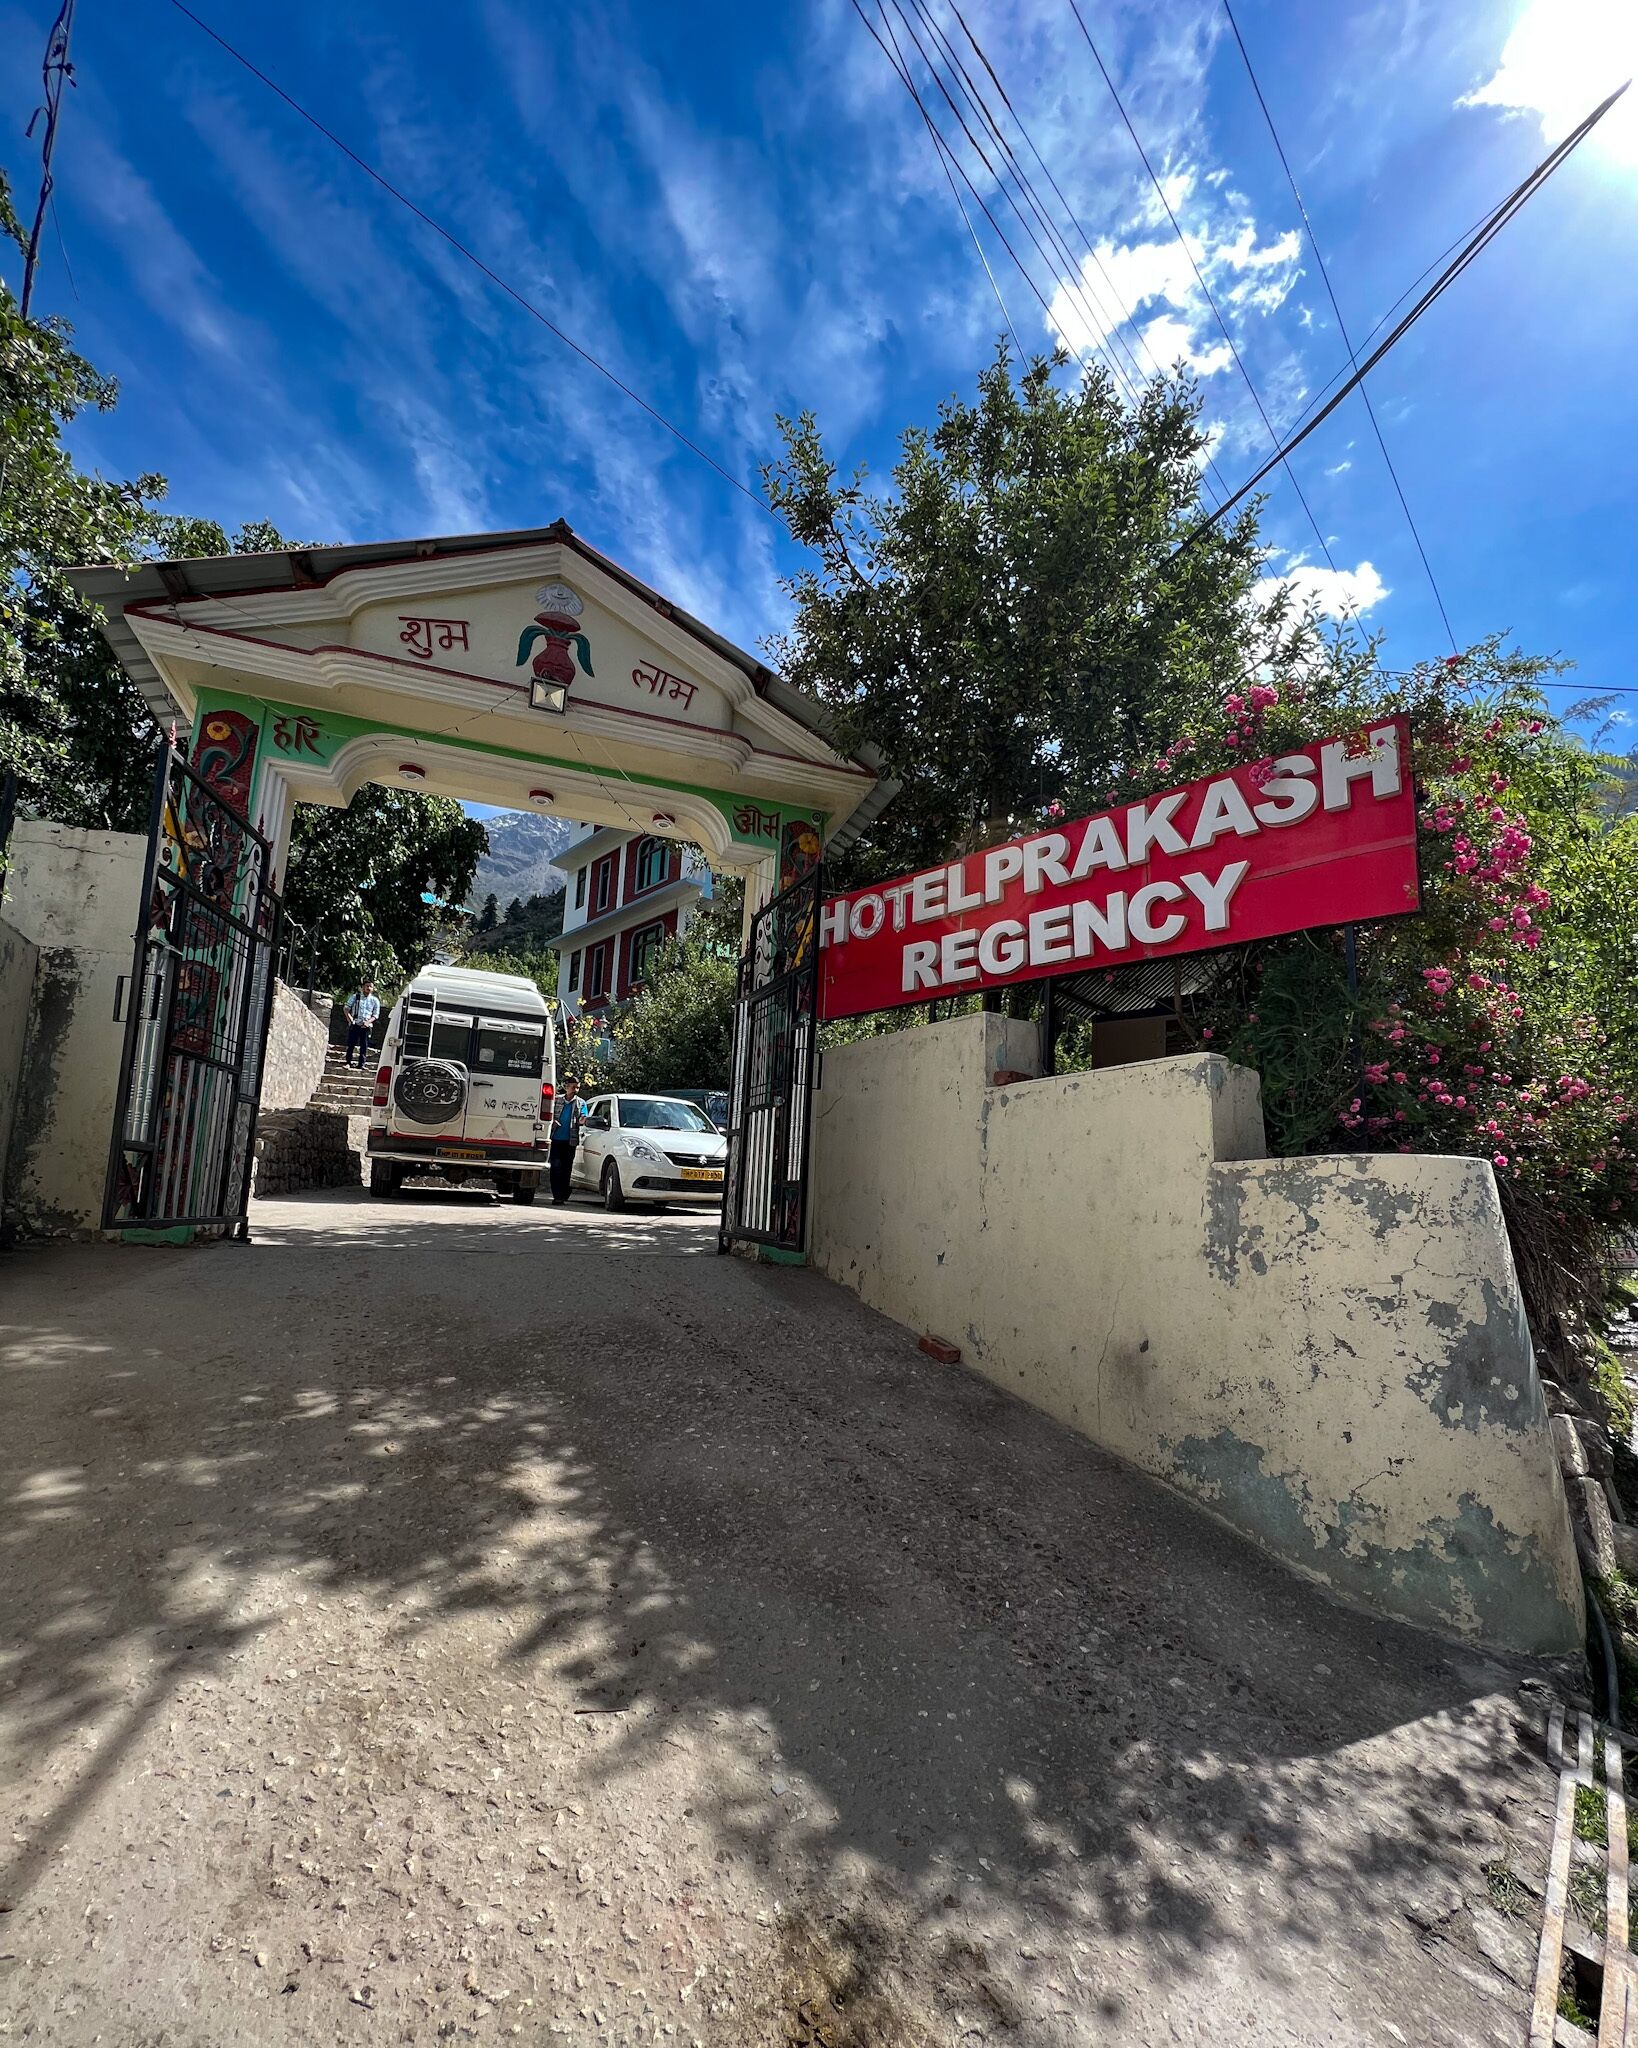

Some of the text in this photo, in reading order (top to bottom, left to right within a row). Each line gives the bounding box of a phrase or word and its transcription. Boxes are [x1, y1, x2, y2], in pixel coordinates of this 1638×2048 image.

[398, 616, 469, 659] शुभ
[632, 659, 699, 711] लाभ
[819, 724, 1402, 948] HOTEL PRAKASH
[902, 860, 1251, 992] REGENCY
